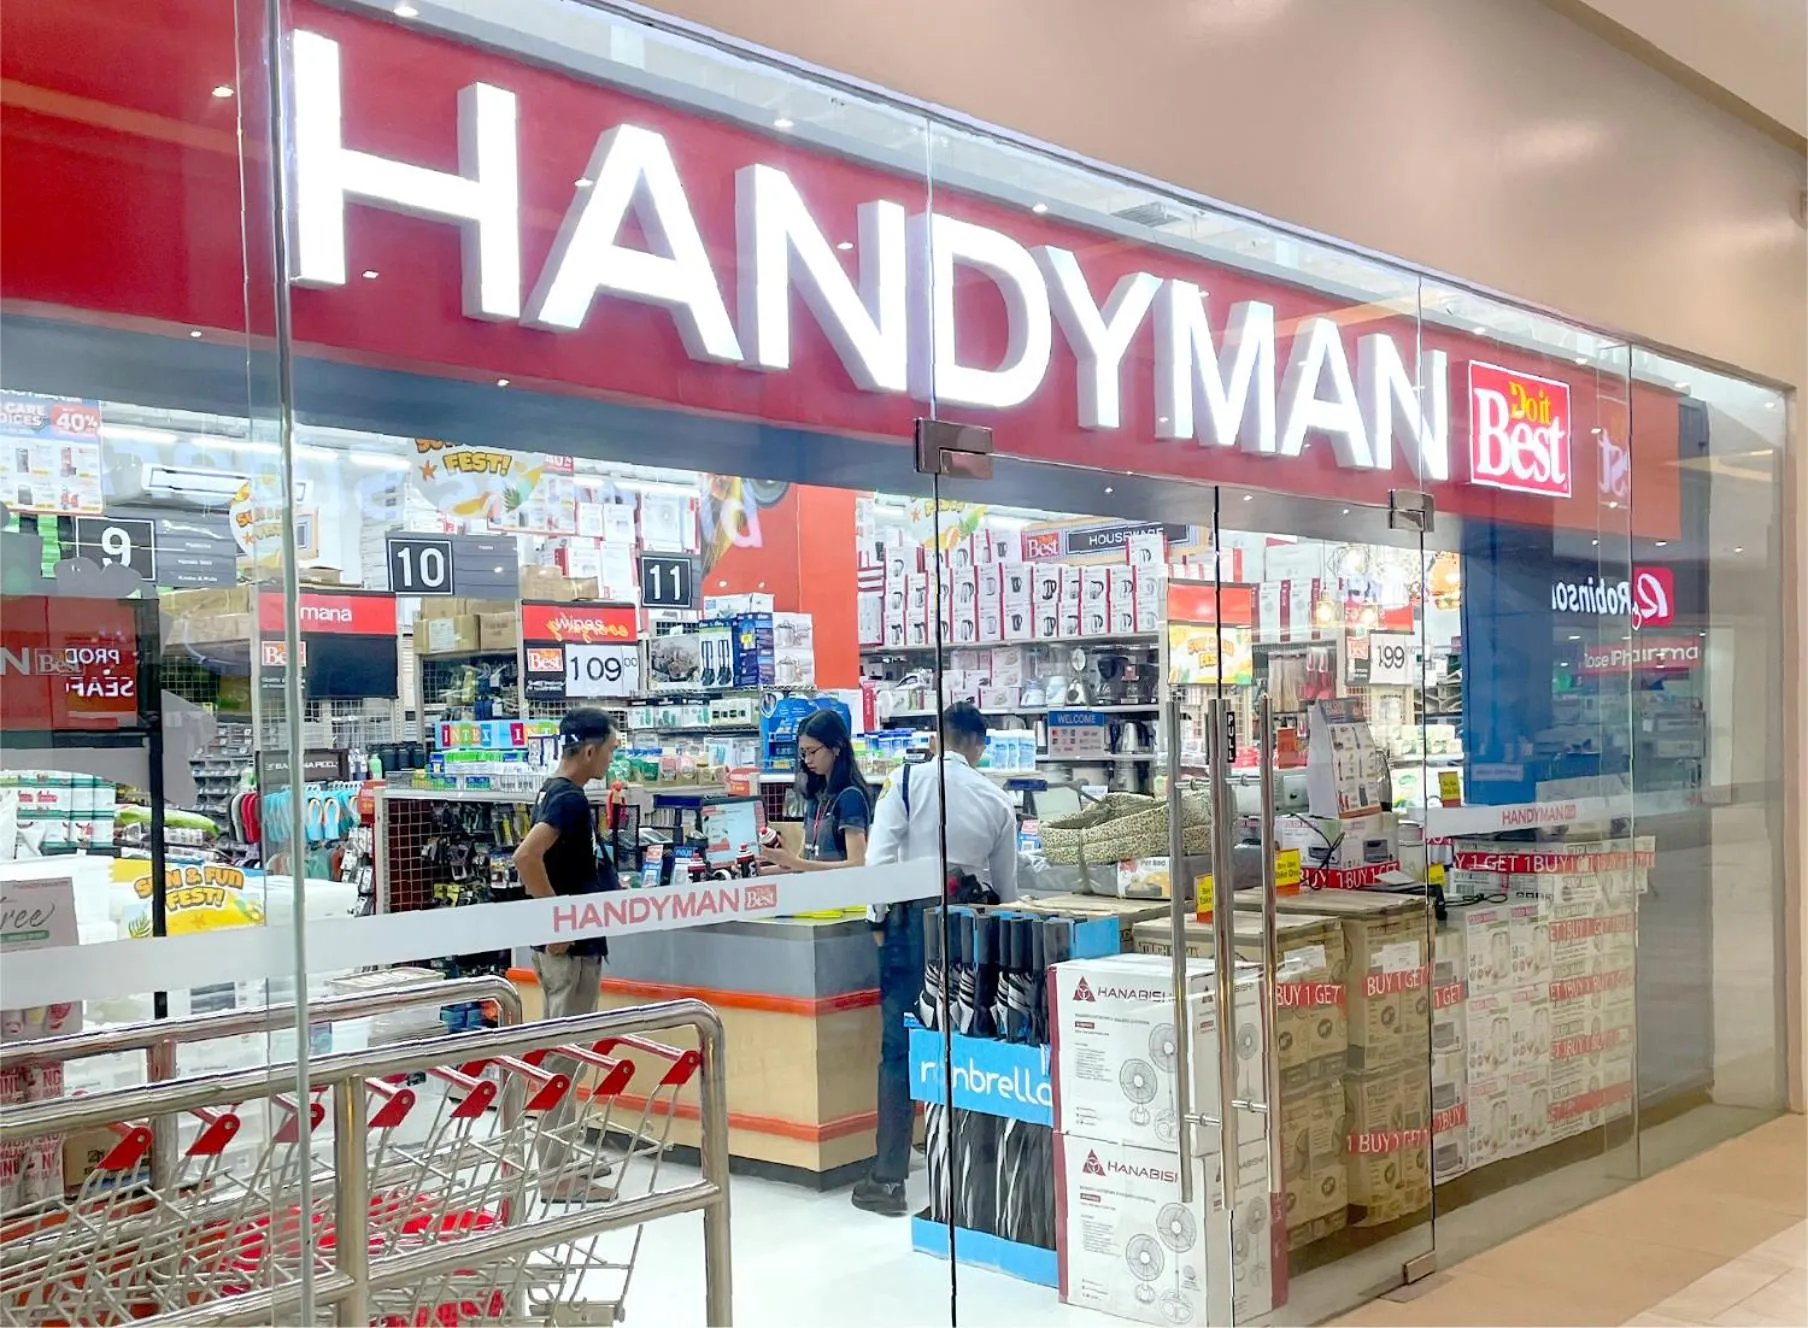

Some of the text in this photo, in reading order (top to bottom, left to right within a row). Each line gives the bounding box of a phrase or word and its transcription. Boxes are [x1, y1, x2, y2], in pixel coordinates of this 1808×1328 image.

[281, 28, 1449, 481] HANDYMAN
[1473, 387, 1567, 484] Best
[443, 451, 513, 477] FEST!
[101, 526, 131, 568] 9
[397, 547, 445, 588] 10
[650, 564, 681, 601] 11
[571, 656, 621, 682] 109
[1377, 645, 1405, 669] 199
[1056, 713, 1097, 725] WELCOME
[443, 728, 491, 744] INTEX
[1227, 714, 1235, 760] PULL
[1502, 804, 1565, 827] HANDYMAN
[134, 865, 245, 900] SN & FUN
[166, 887, 226, 911] FEST!
[553, 887, 741, 933] HANDYMAN
[1367, 972, 1396, 997] BUY
[921, 1057, 1054, 1107] rnbrella
[1359, 1132, 1391, 1153] BUY
